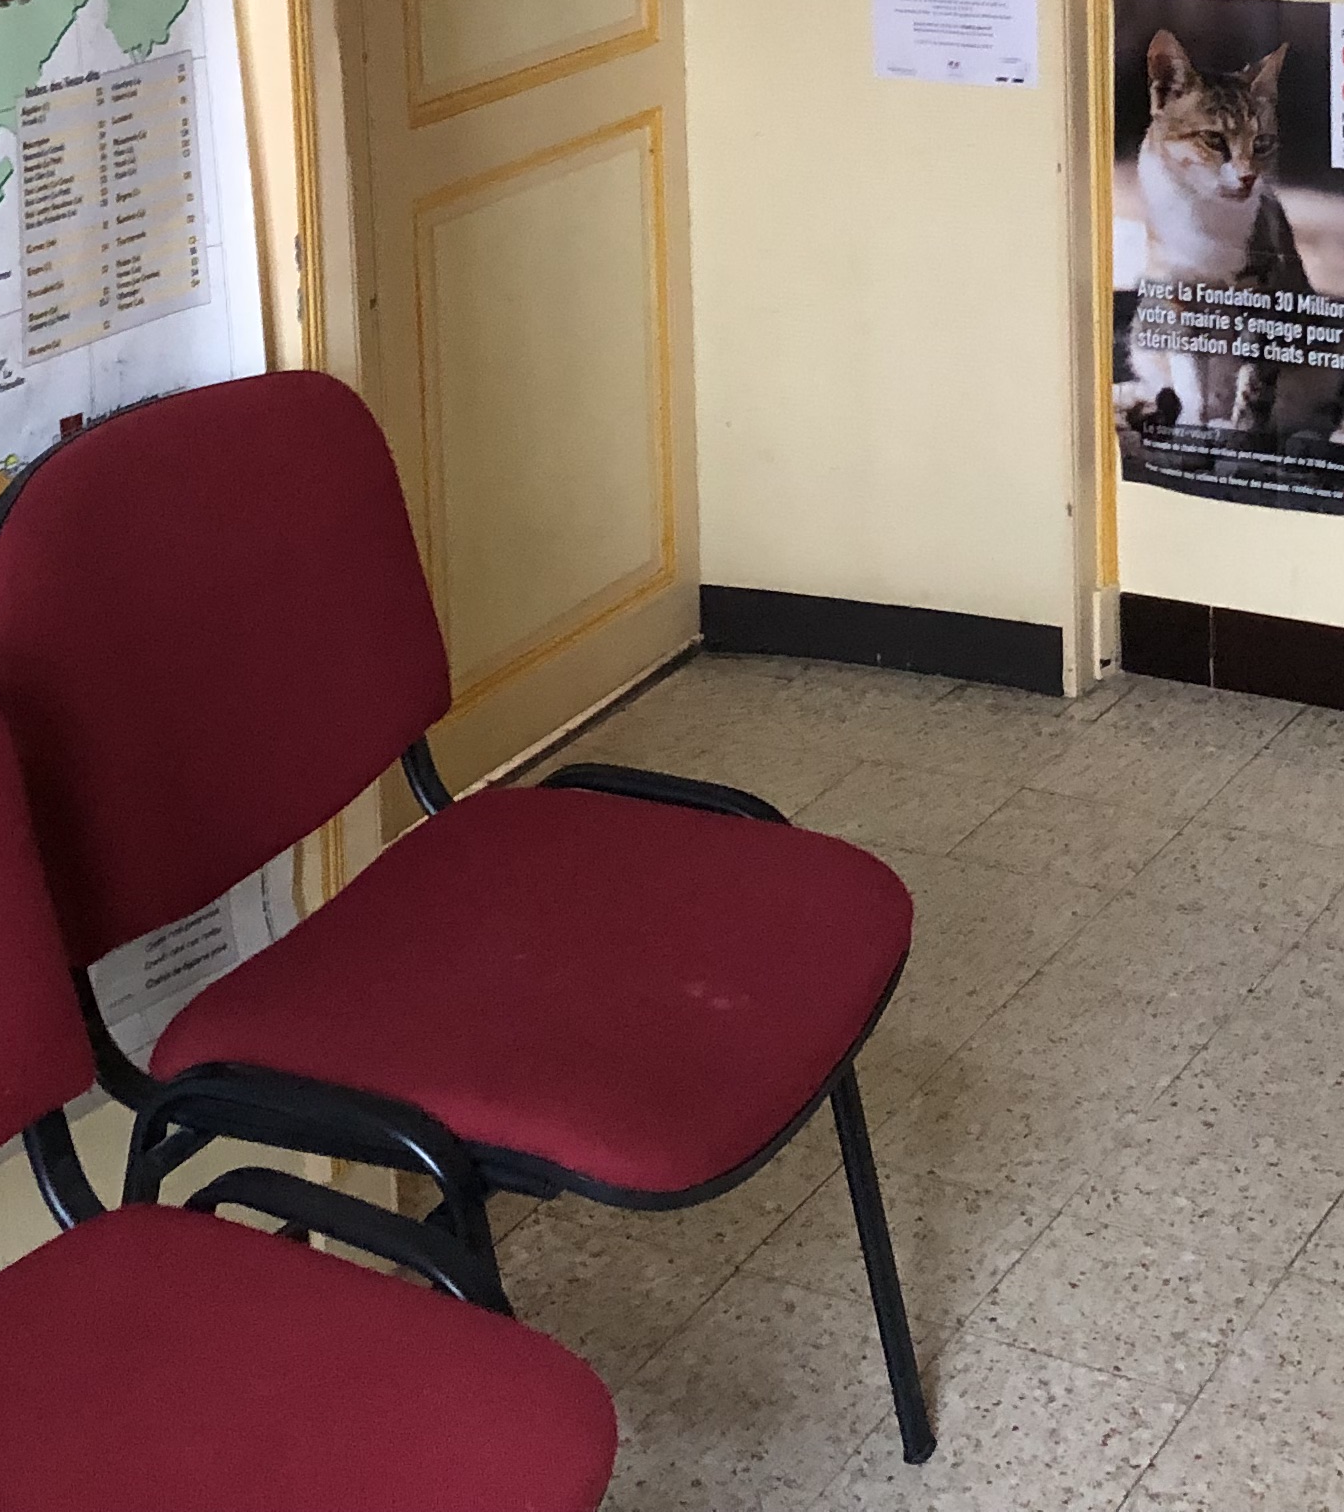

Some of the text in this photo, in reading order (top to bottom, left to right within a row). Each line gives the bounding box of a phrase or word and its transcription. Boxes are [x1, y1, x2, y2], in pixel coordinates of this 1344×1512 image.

[1137, 280, 1173, 300] Avec
[1178, 281, 1192, 303] la
[1196, 282, 1271, 310] Fondation
[1274, 291, 1294, 313] 30
[1137, 306, 1176, 325] votre
[1180, 309, 1229, 330] mairie
[1233, 313, 1302, 340] s'engage
[1306, 325, 1342, 346] pour
[1137, 329, 1228, 355] stérilisation
[1232, 338, 1260, 358] des
[1263, 341, 1305, 365] chats
